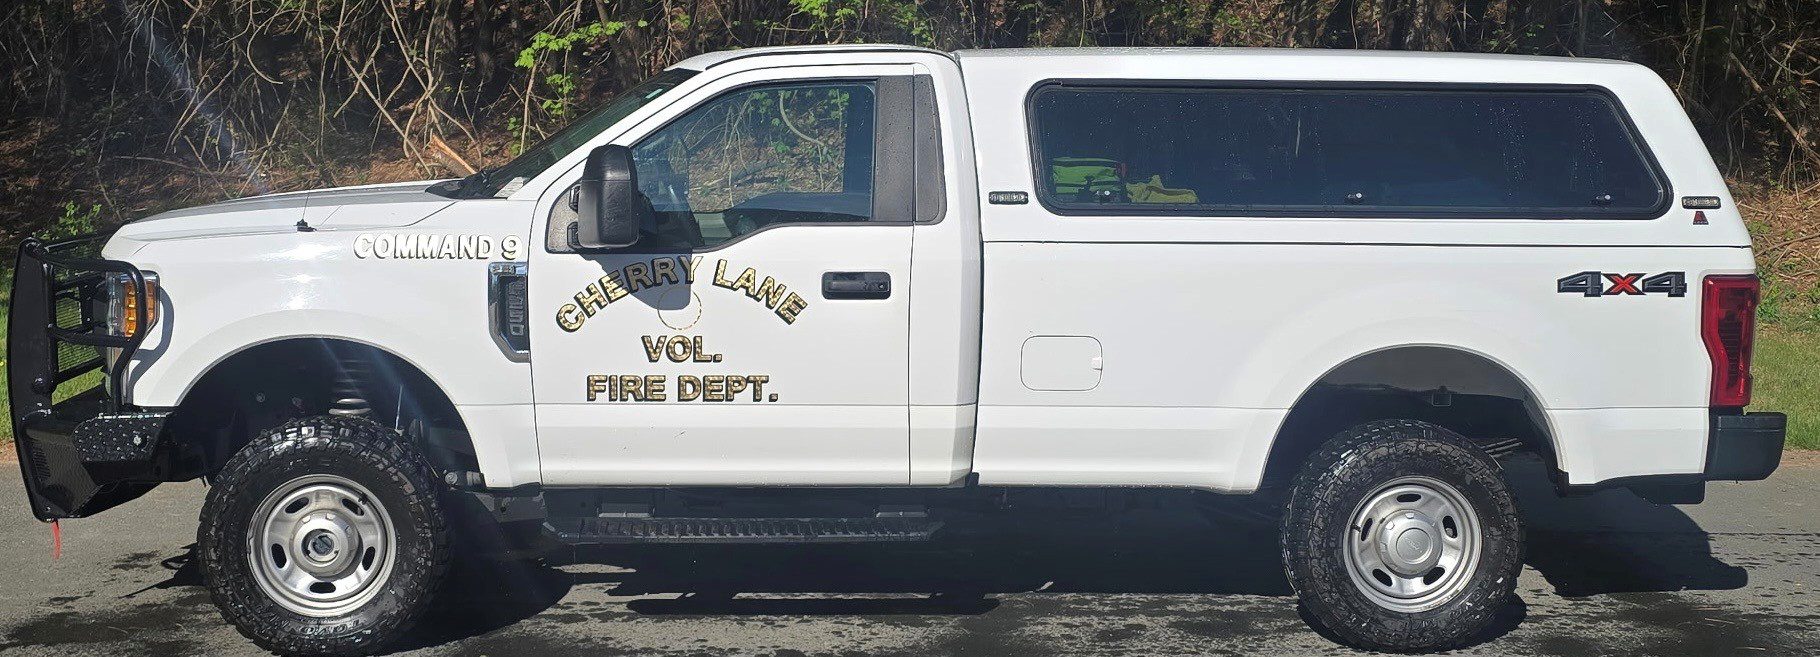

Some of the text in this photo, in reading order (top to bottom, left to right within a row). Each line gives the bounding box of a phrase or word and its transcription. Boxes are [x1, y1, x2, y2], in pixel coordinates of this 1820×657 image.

[353, 233, 522, 260] COMMAND 9
[556, 255, 808, 333] CHERRY LANE
[641, 335, 722, 363] VOL.
[587, 375, 778, 402] FIRE DEPT.
